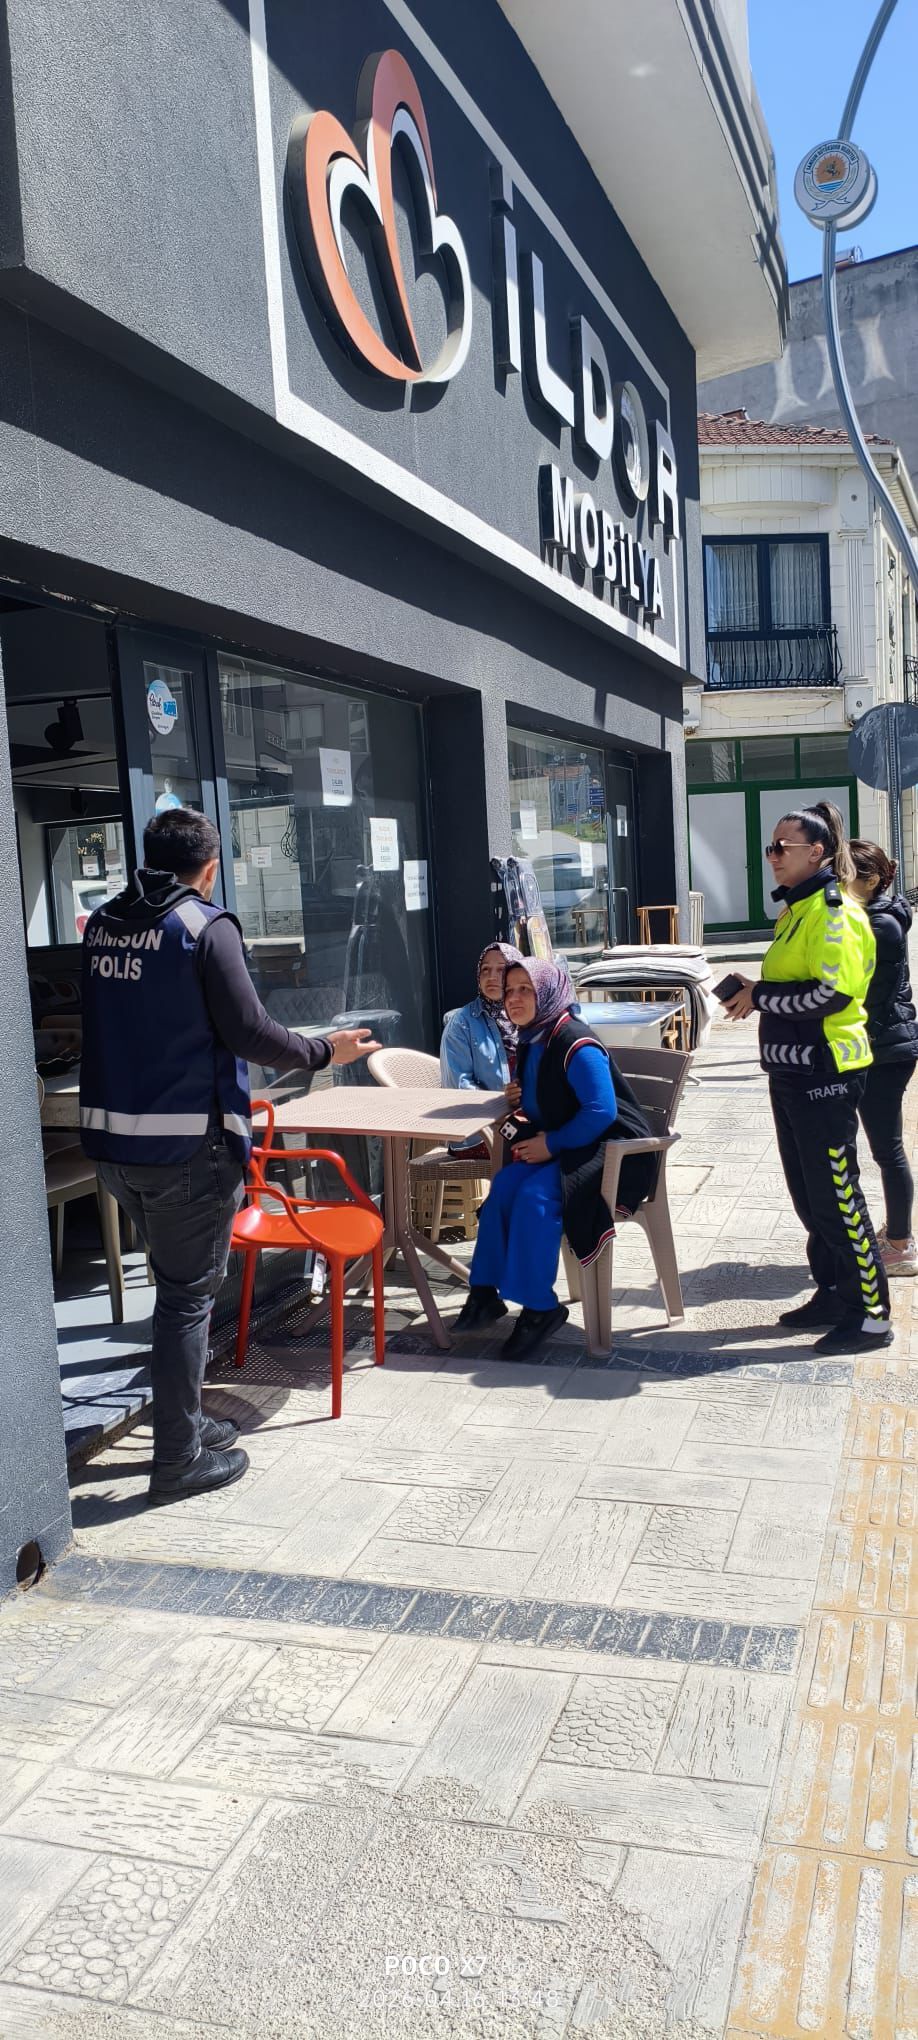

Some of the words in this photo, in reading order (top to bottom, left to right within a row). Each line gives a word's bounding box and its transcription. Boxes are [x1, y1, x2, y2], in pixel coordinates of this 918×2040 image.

[501, 162, 680, 540] İLDOR
[87, 926, 164, 951] SAMSUN
[91, 952, 142, 980] POLİS
